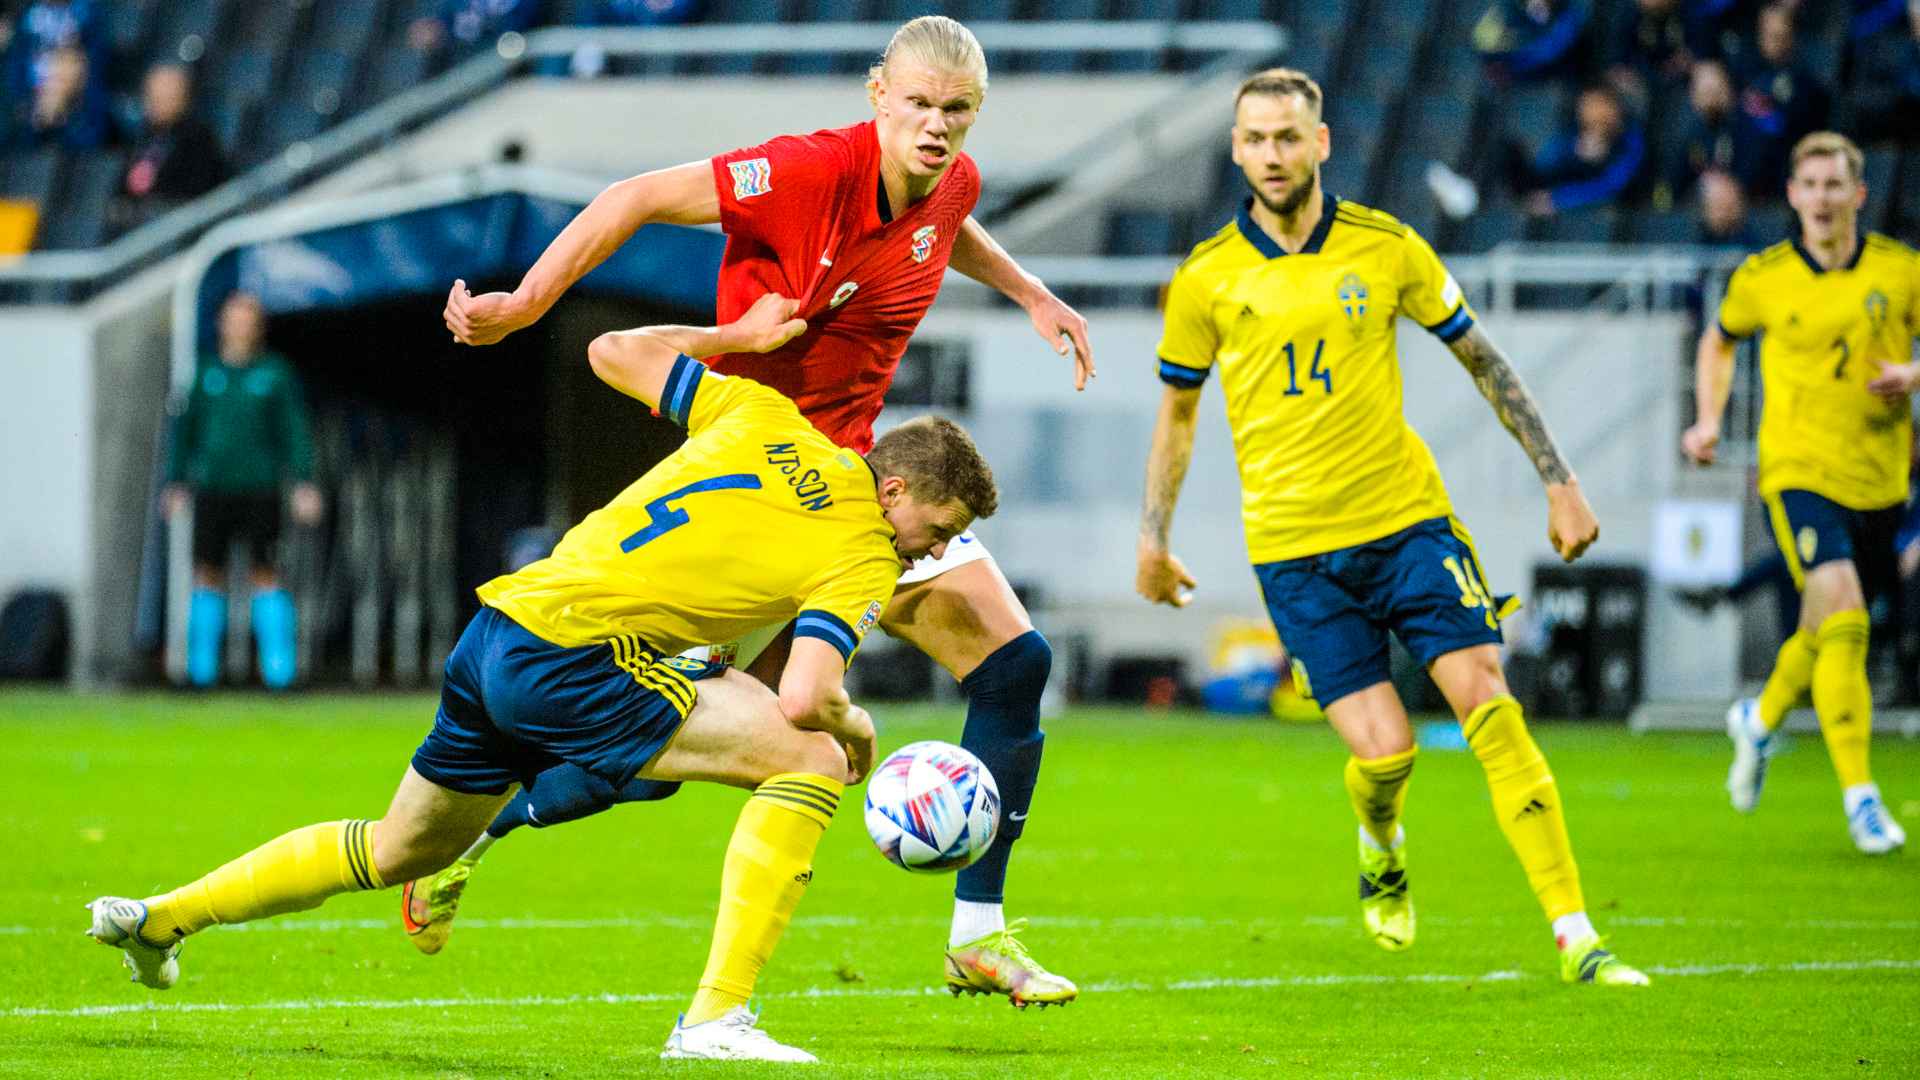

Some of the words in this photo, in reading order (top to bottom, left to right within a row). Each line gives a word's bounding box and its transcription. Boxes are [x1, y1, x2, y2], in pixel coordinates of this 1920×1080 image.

[1282, 339, 1332, 395] 14
[1832, 336, 1850, 379] 2
[619, 473, 762, 553] 4
